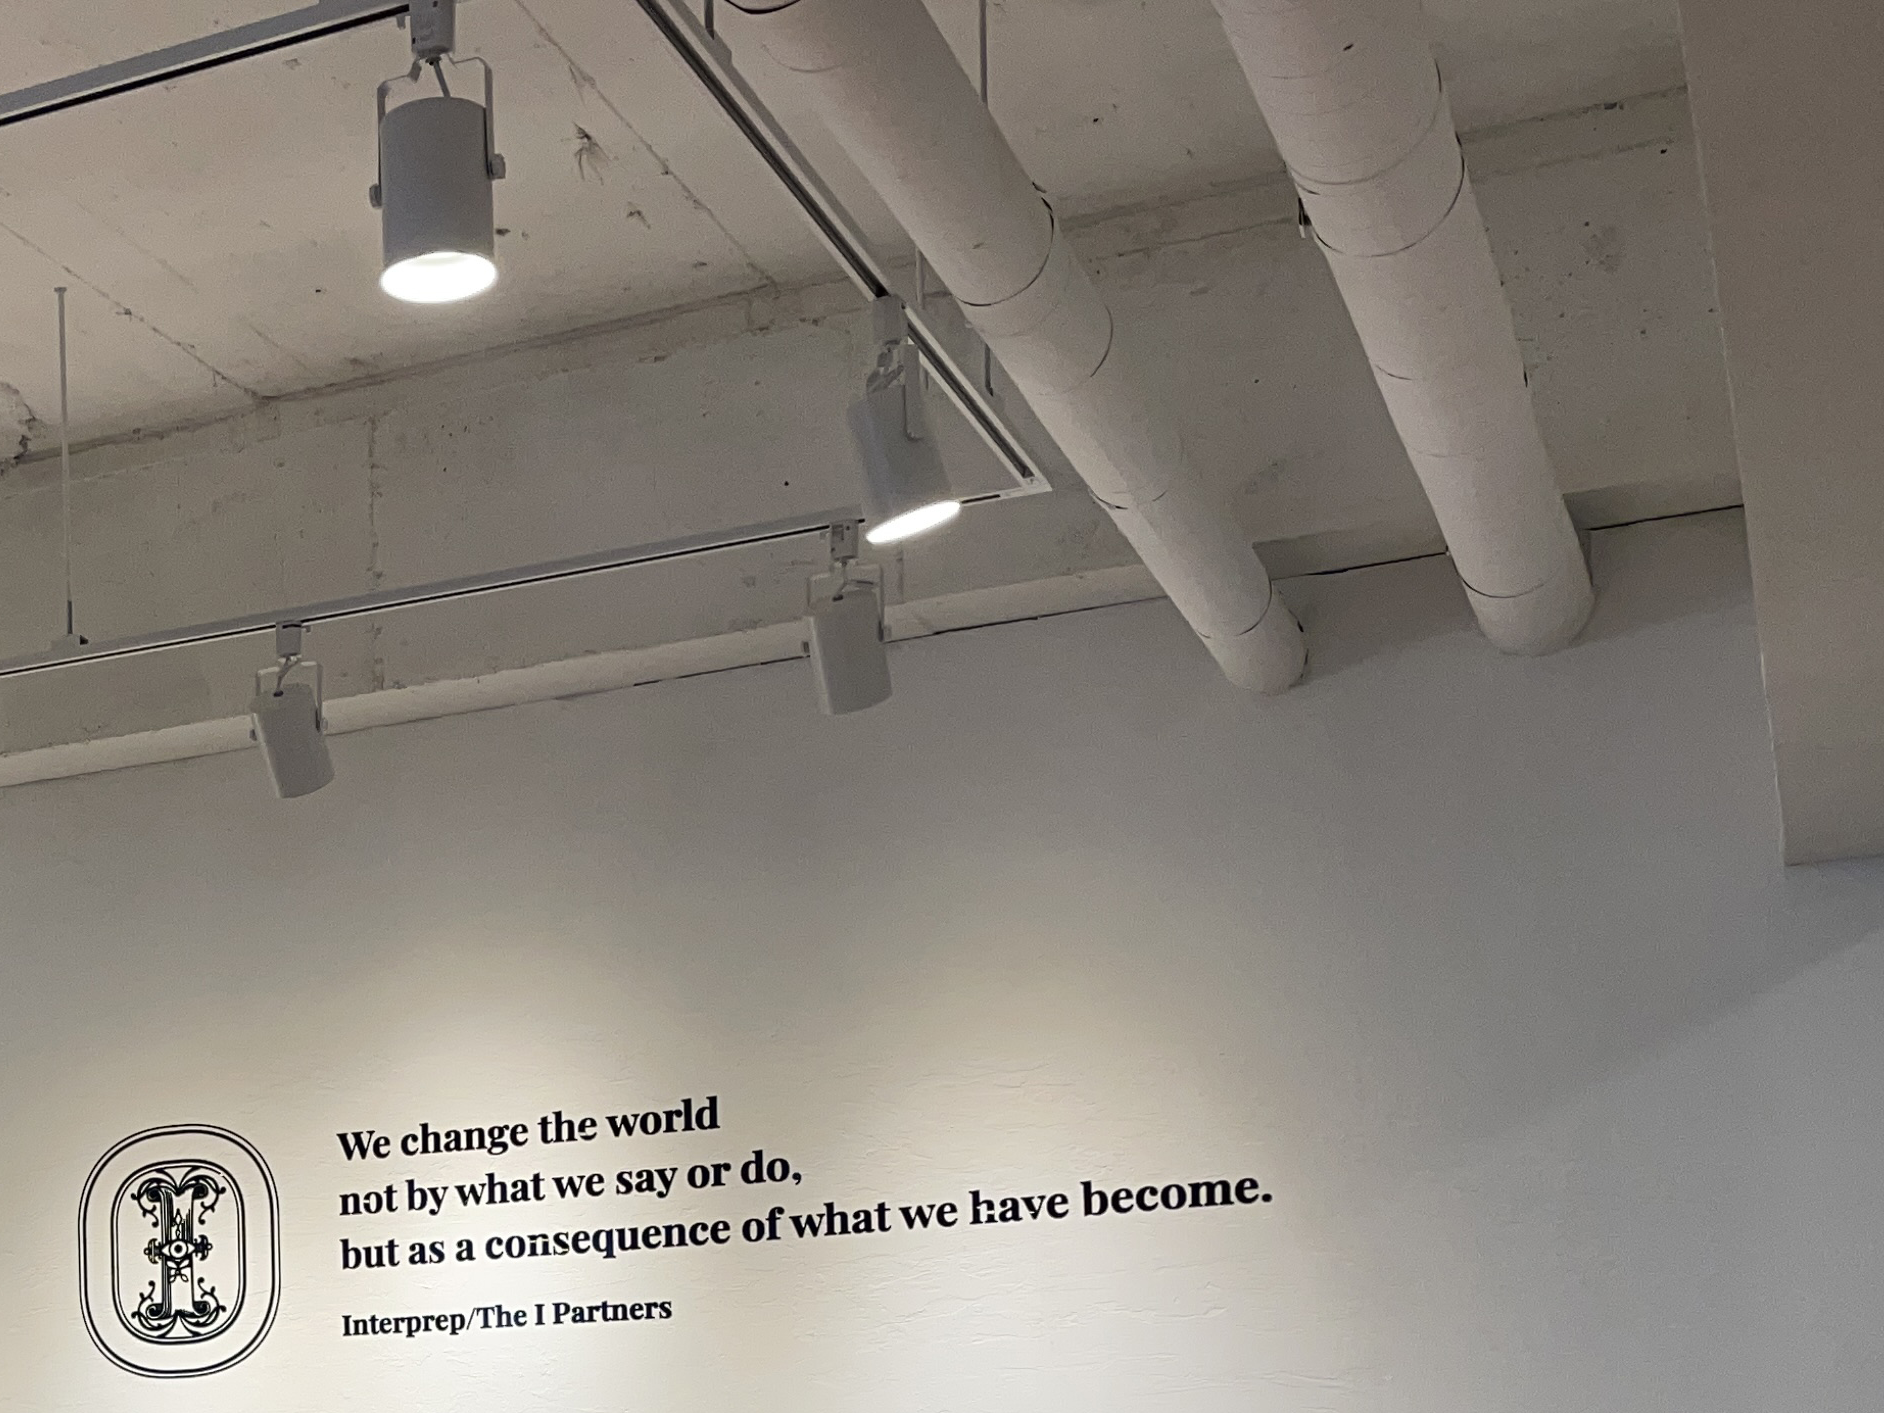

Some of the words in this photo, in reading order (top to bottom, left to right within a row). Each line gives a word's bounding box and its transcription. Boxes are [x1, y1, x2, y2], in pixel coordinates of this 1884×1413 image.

[336, 1130, 391, 1161] We
[400, 1122, 529, 1156] change
[537, 1110, 598, 1145] the
[605, 1095, 721, 1138] world
[339, 1184, 399, 1216] not
[405, 1178, 449, 1216] by
[454, 1172, 546, 1207] what
[551, 1173, 605, 1199] we
[615, 1167, 679, 1199] say
[687, 1162, 732, 1189] or
[740, 1149, 802, 1186] do,
[340, 1238, 400, 1270] but
[408, 1241, 445, 1265] as
[455, 1239, 476, 1262] a
[485, 1220, 731, 1260] consequence
[741, 1206, 785, 1243] of
[788, 1201, 892, 1239] what
[898, 1202, 958, 1230] we
[968, 1189, 1069, 1225] have
[1080, 1177, 1273, 1217] become.
[341, 1304, 527, 1338] Interprep/The
[534, 1303, 546, 1326] I
[552, 1300, 672, 1325] Partners
